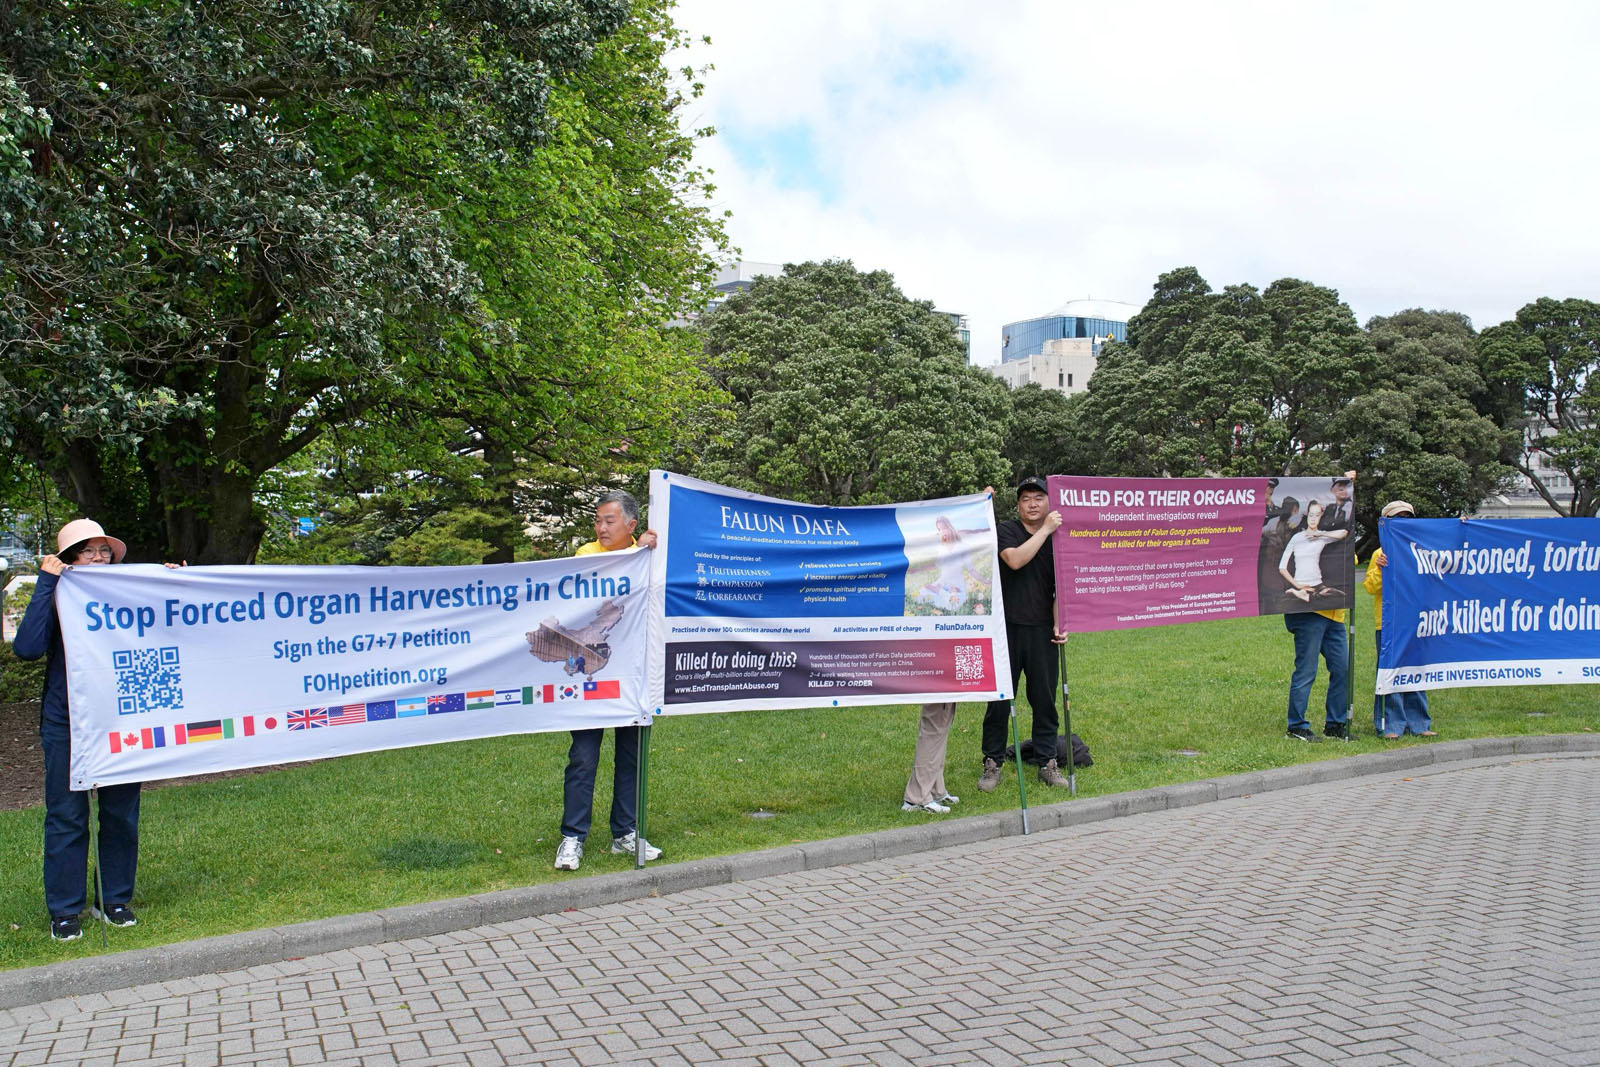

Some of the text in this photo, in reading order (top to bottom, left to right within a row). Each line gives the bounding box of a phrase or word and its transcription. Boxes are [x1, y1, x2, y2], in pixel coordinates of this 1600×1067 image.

[1060, 488, 1256, 506] KILLED FOR THEIR ORGANS
[720, 505, 851, 536] FALUN DAFA
[1098, 510, 1218, 522] Independent investigations reveal
[1070, 524, 1243, 538] Hundreds of thousands of Falun Gong practitioners have
[727, 534, 750, 542] peaceful
[752, 536, 782, 544] meditation
[1100, 537, 1210, 549] been killed for their organs in China
[730, 554, 754, 562] principles
[1410, 540, 1600, 580] Imprisoned, tortu
[708, 565, 772, 576] TRUTHFULNESS
[1089, 564, 1116, 573] absolutely
[1116, 564, 1144, 572] convinced
[1174, 562, 1185, 570] long
[1186, 560, 1204, 568] period,
[1098, 576, 1114, 584] organ
[1156, 572, 1180, 580] prisoners
[1187, 569, 1217, 577] conscience
[711, 578, 764, 588] COMPASSION
[1075, 586, 1088, 594] been
[1089, 586, 1106, 594] taking
[1122, 583, 1148, 592] especially
[858, 586, 878, 594] growth
[708, 592, 764, 601] FORBEARANCE
[86, 571, 631, 637] Stop Forced Organ Harvesting in China
[1417, 598, 1600, 638] and killed for doin
[902, 625, 922, 633] charge
[935, 622, 984, 632] FalunDafa.org
[273, 628, 471, 663] Sign the G7+7 Petition
[675, 651, 798, 671] Killed for doing this?
[904, 652, 936, 660] practitioners
[710, 670, 742, 678] multi-billion
[760, 670, 782, 678] industry
[1393, 673, 1422, 686] READ
[1424, 672, 1444, 683] THE
[1446, 668, 1542, 681] INVESTIGATIONS
[303, 666, 448, 695] FOHpetition.org
[674, 682, 780, 694] www.EndTransplantAbuse.org
